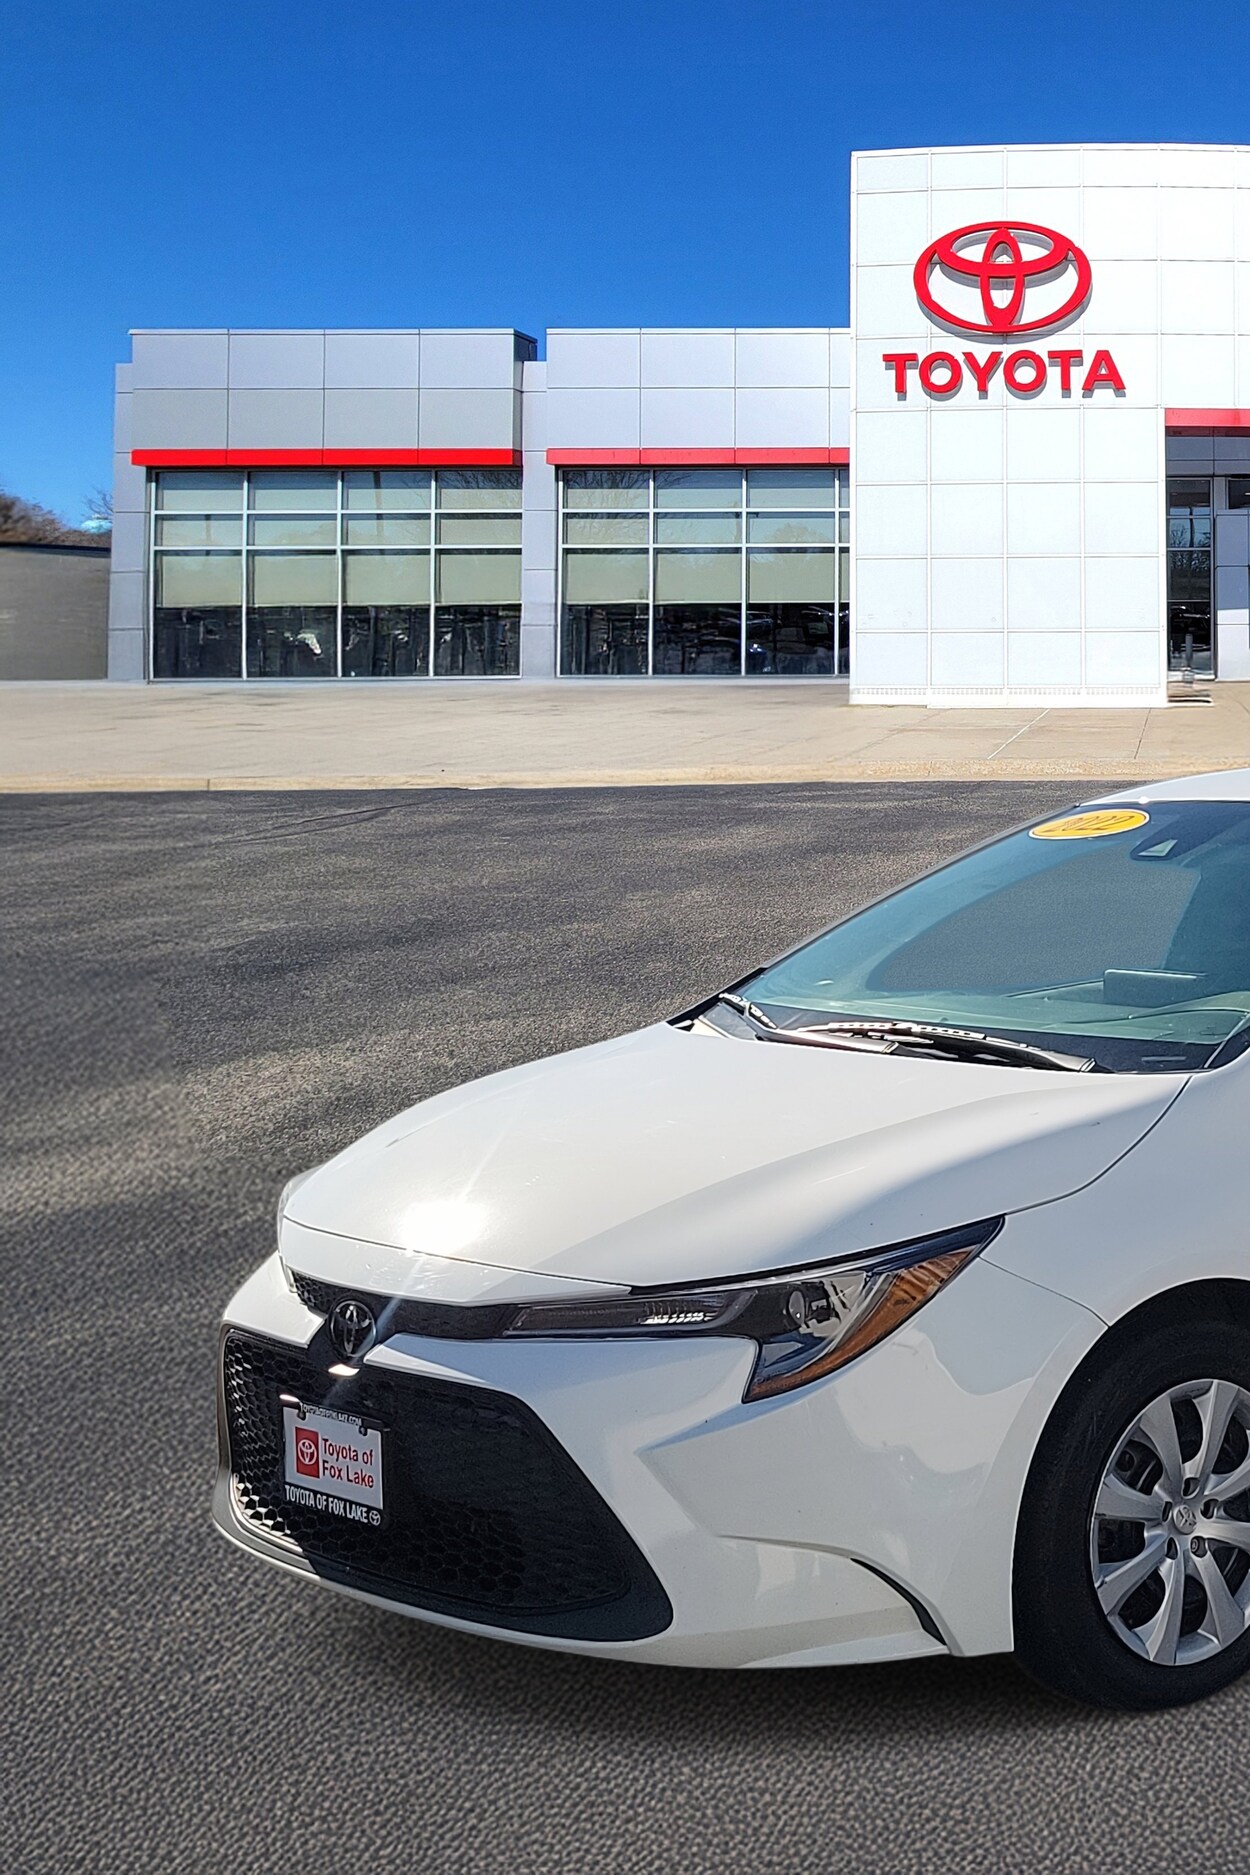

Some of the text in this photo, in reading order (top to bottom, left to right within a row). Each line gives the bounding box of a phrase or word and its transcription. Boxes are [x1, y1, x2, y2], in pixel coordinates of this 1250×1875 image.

[882, 350, 1126, 397] TOYOTA
[321, 1438, 374, 1466] Toyota of
[321, 1460, 374, 1488] Fox Lake
[285, 1485, 368, 1523] TOYOTA OF FOX LAKE
